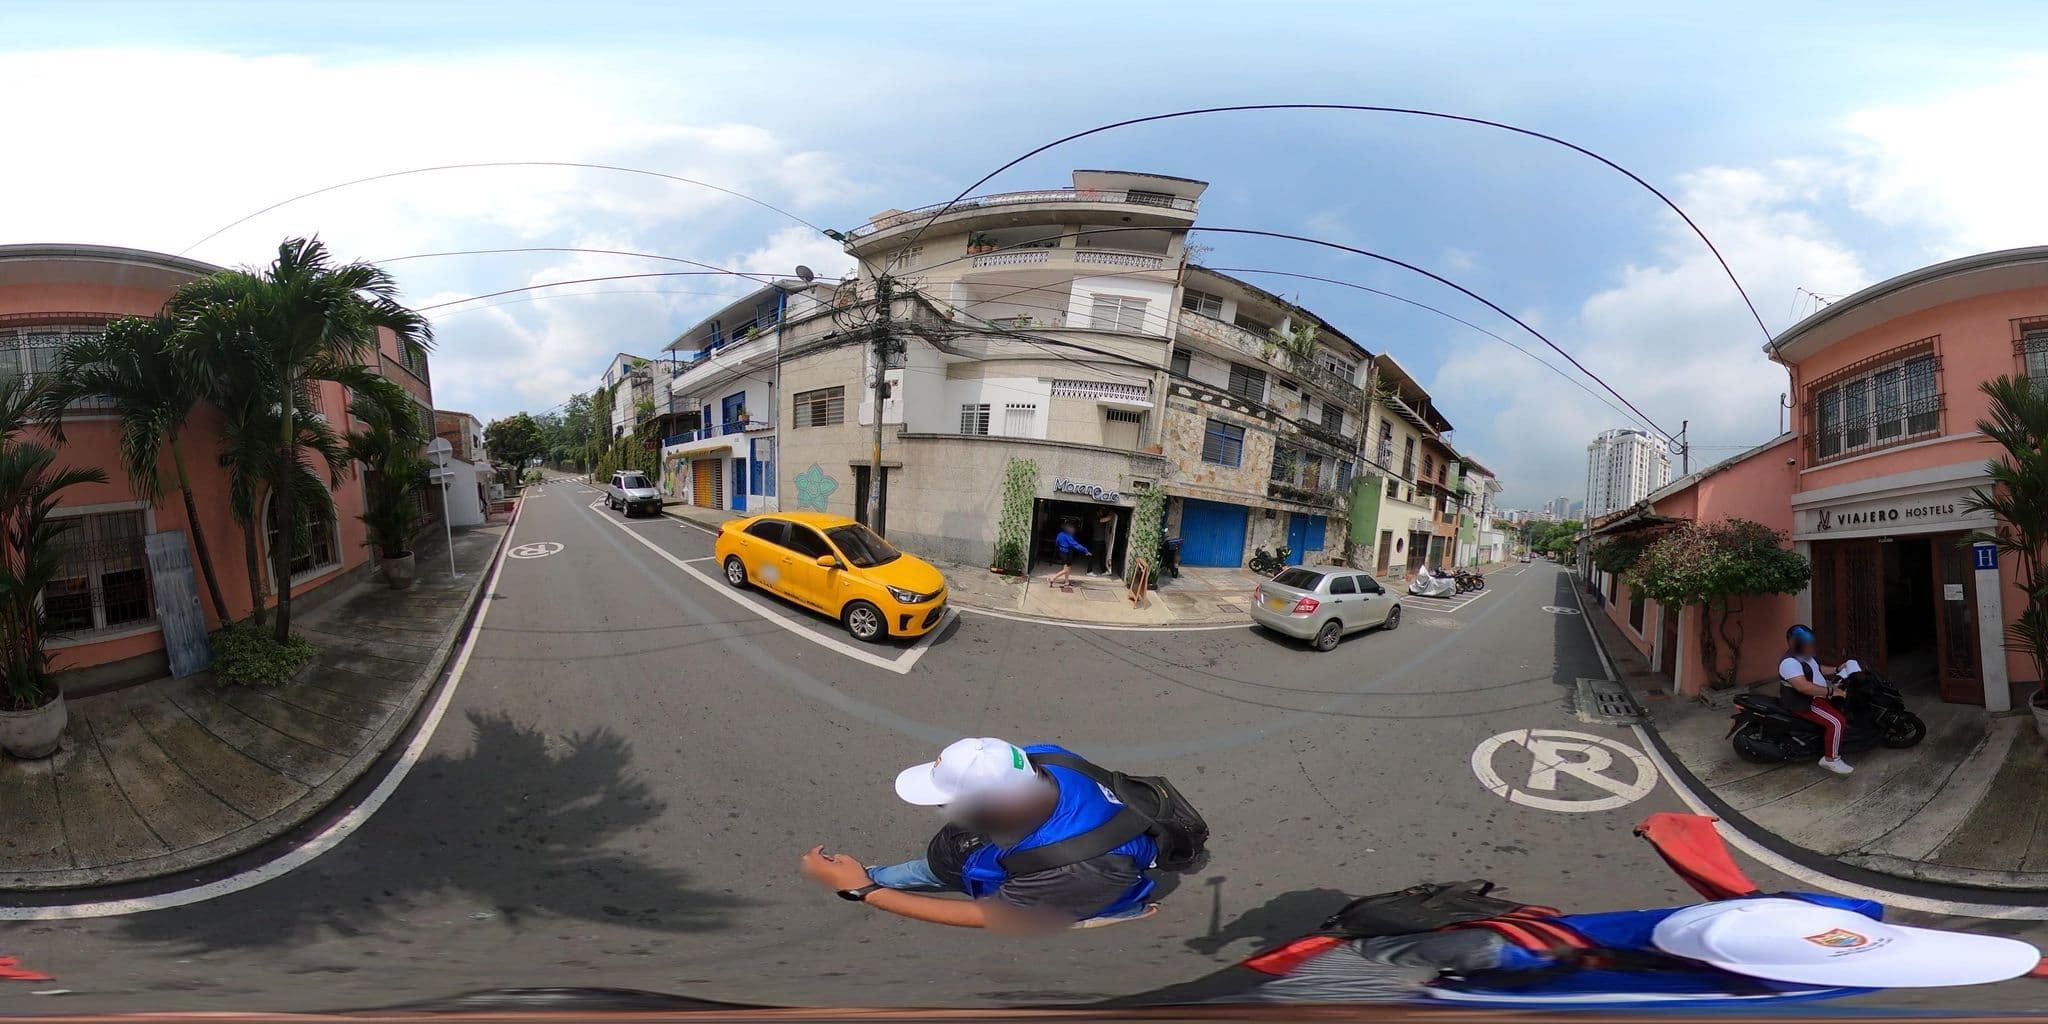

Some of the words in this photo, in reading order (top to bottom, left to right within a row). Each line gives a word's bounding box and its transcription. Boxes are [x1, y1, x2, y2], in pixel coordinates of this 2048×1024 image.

[1837, 508, 1899, 526] VIAJERO
[1905, 504, 1954, 519] HOSTELS
[1977, 549, 1994, 568] H
